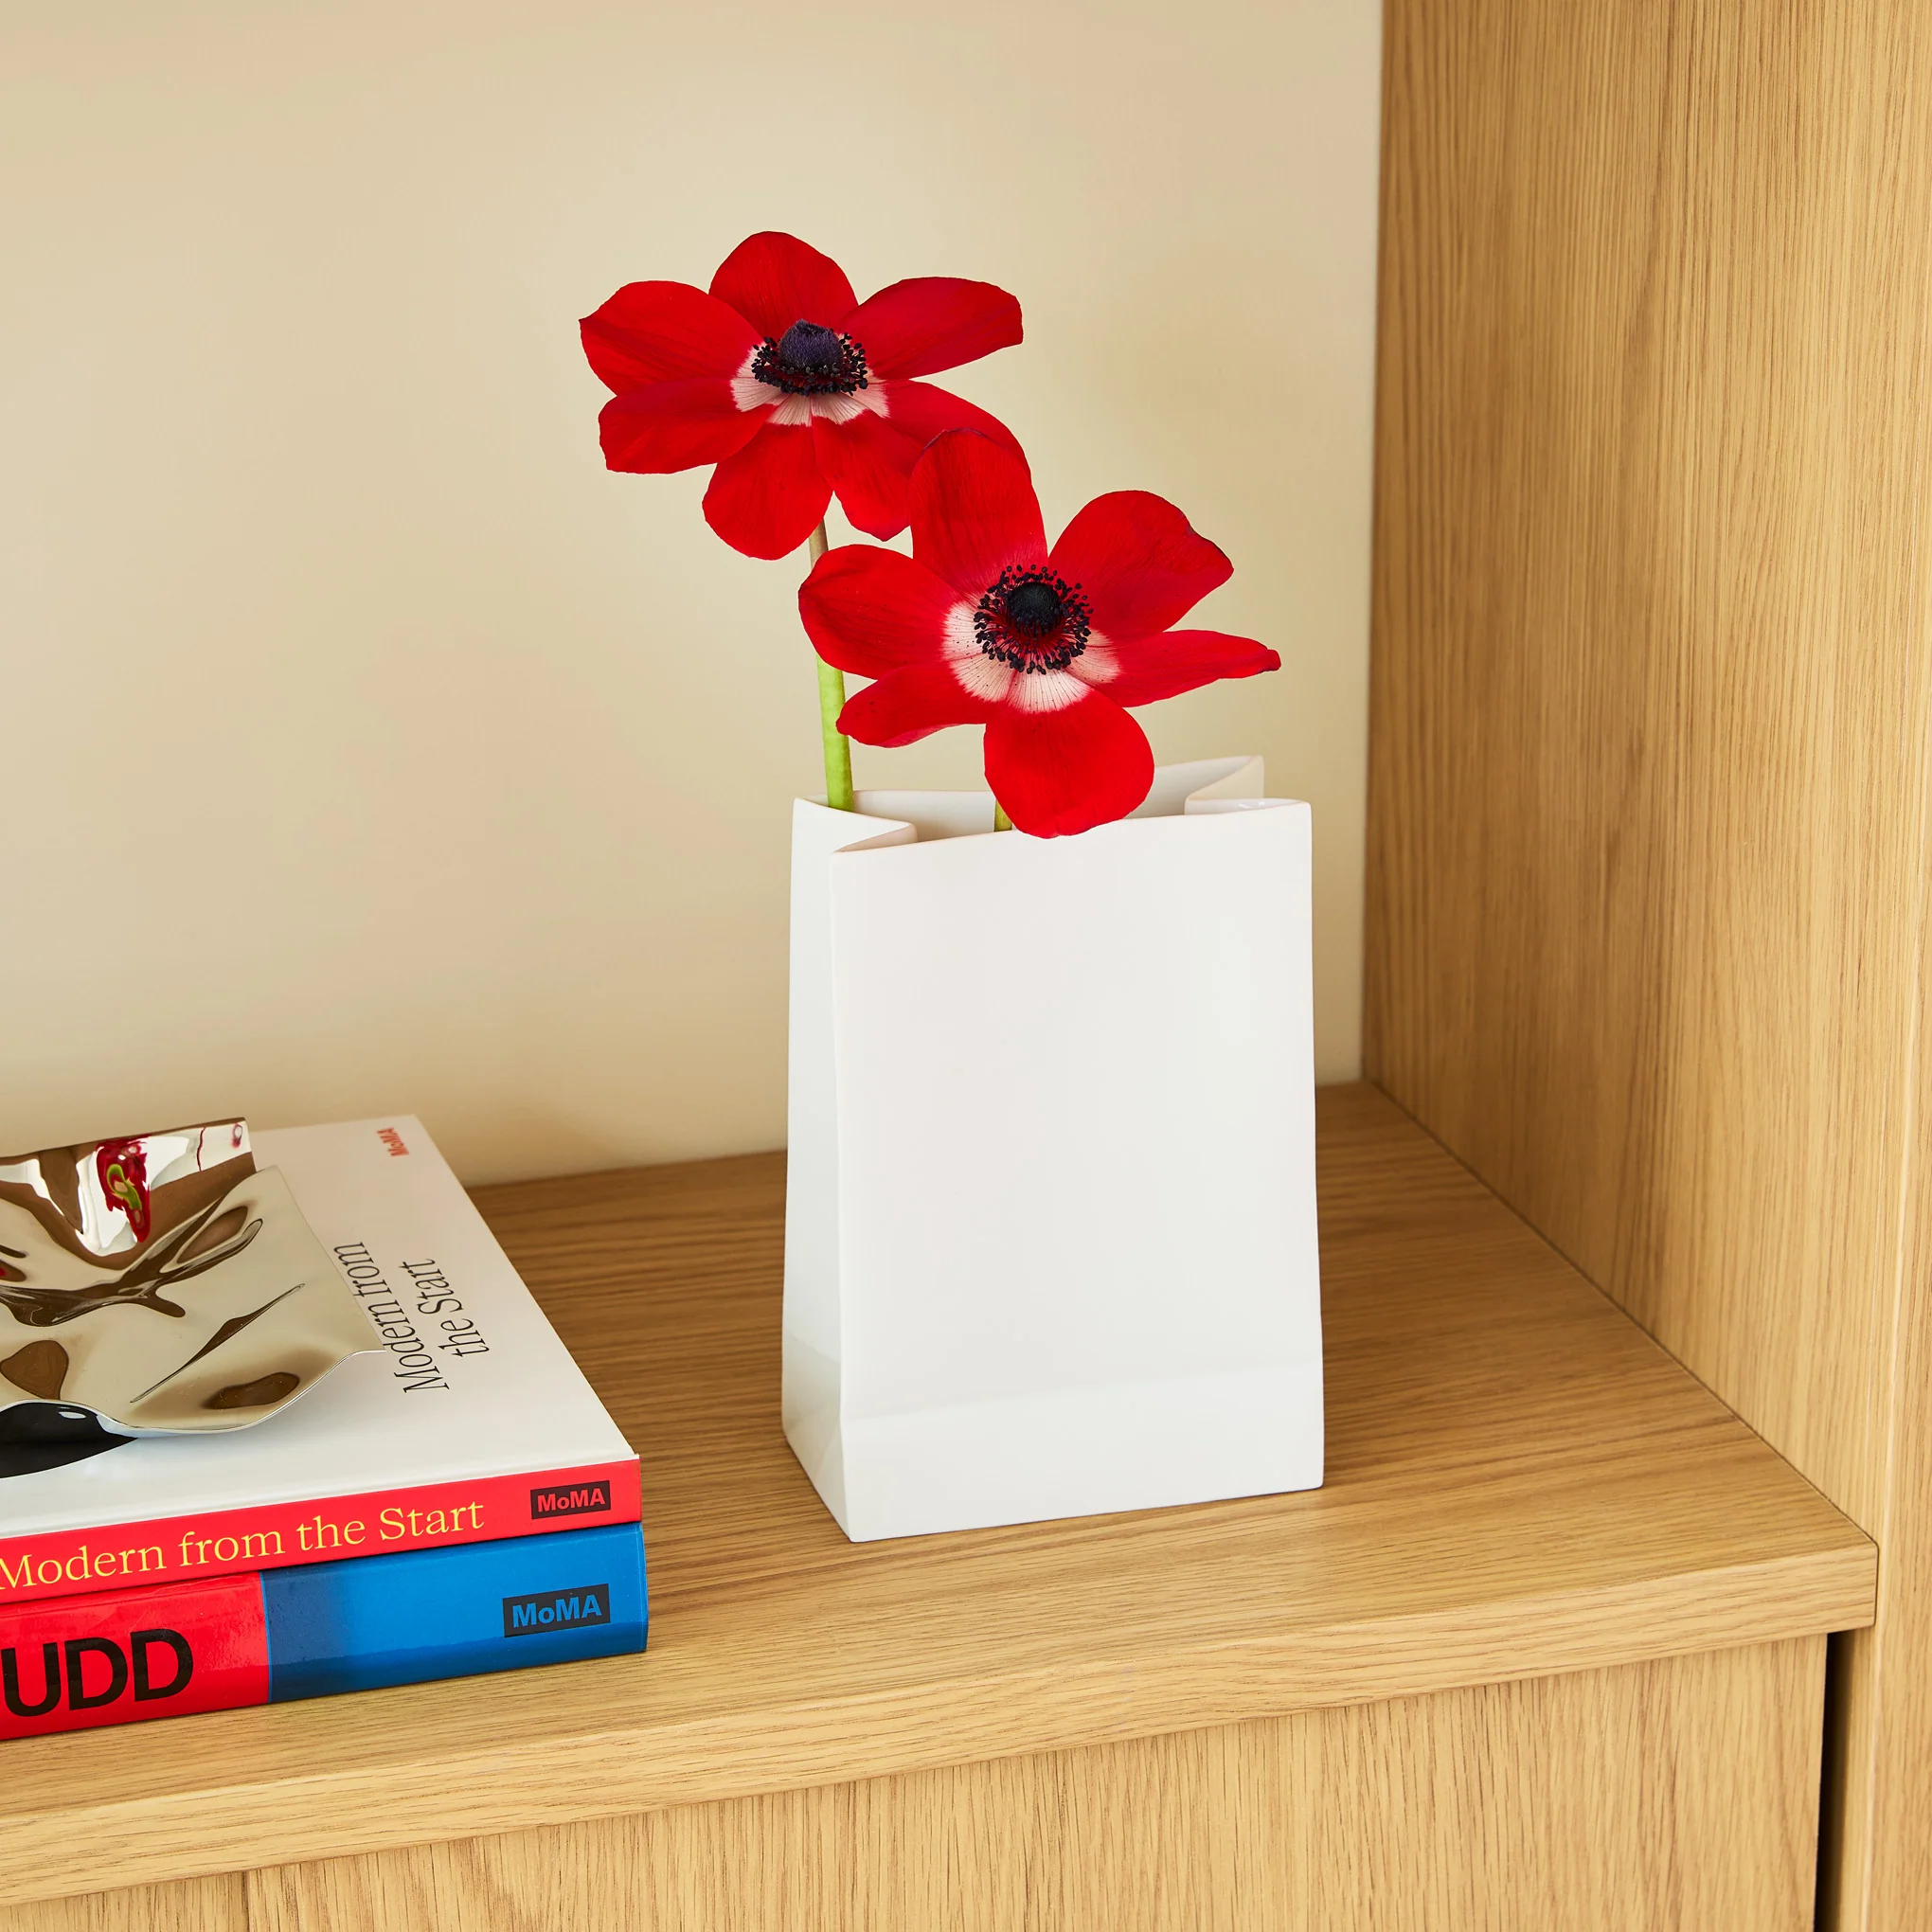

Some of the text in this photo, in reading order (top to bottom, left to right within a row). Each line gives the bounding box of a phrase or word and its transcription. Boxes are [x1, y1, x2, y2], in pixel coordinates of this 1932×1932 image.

[377, 1127, 409, 1156] MoMA
[333, 1242, 450, 1393] Modern from
[398, 1259, 490, 1357] the Start
[537, 1487, 606, 1512] MoMA
[0, 1501, 485, 1590] Modern from the Start
[512, 1594, 602, 1628] MoMA
